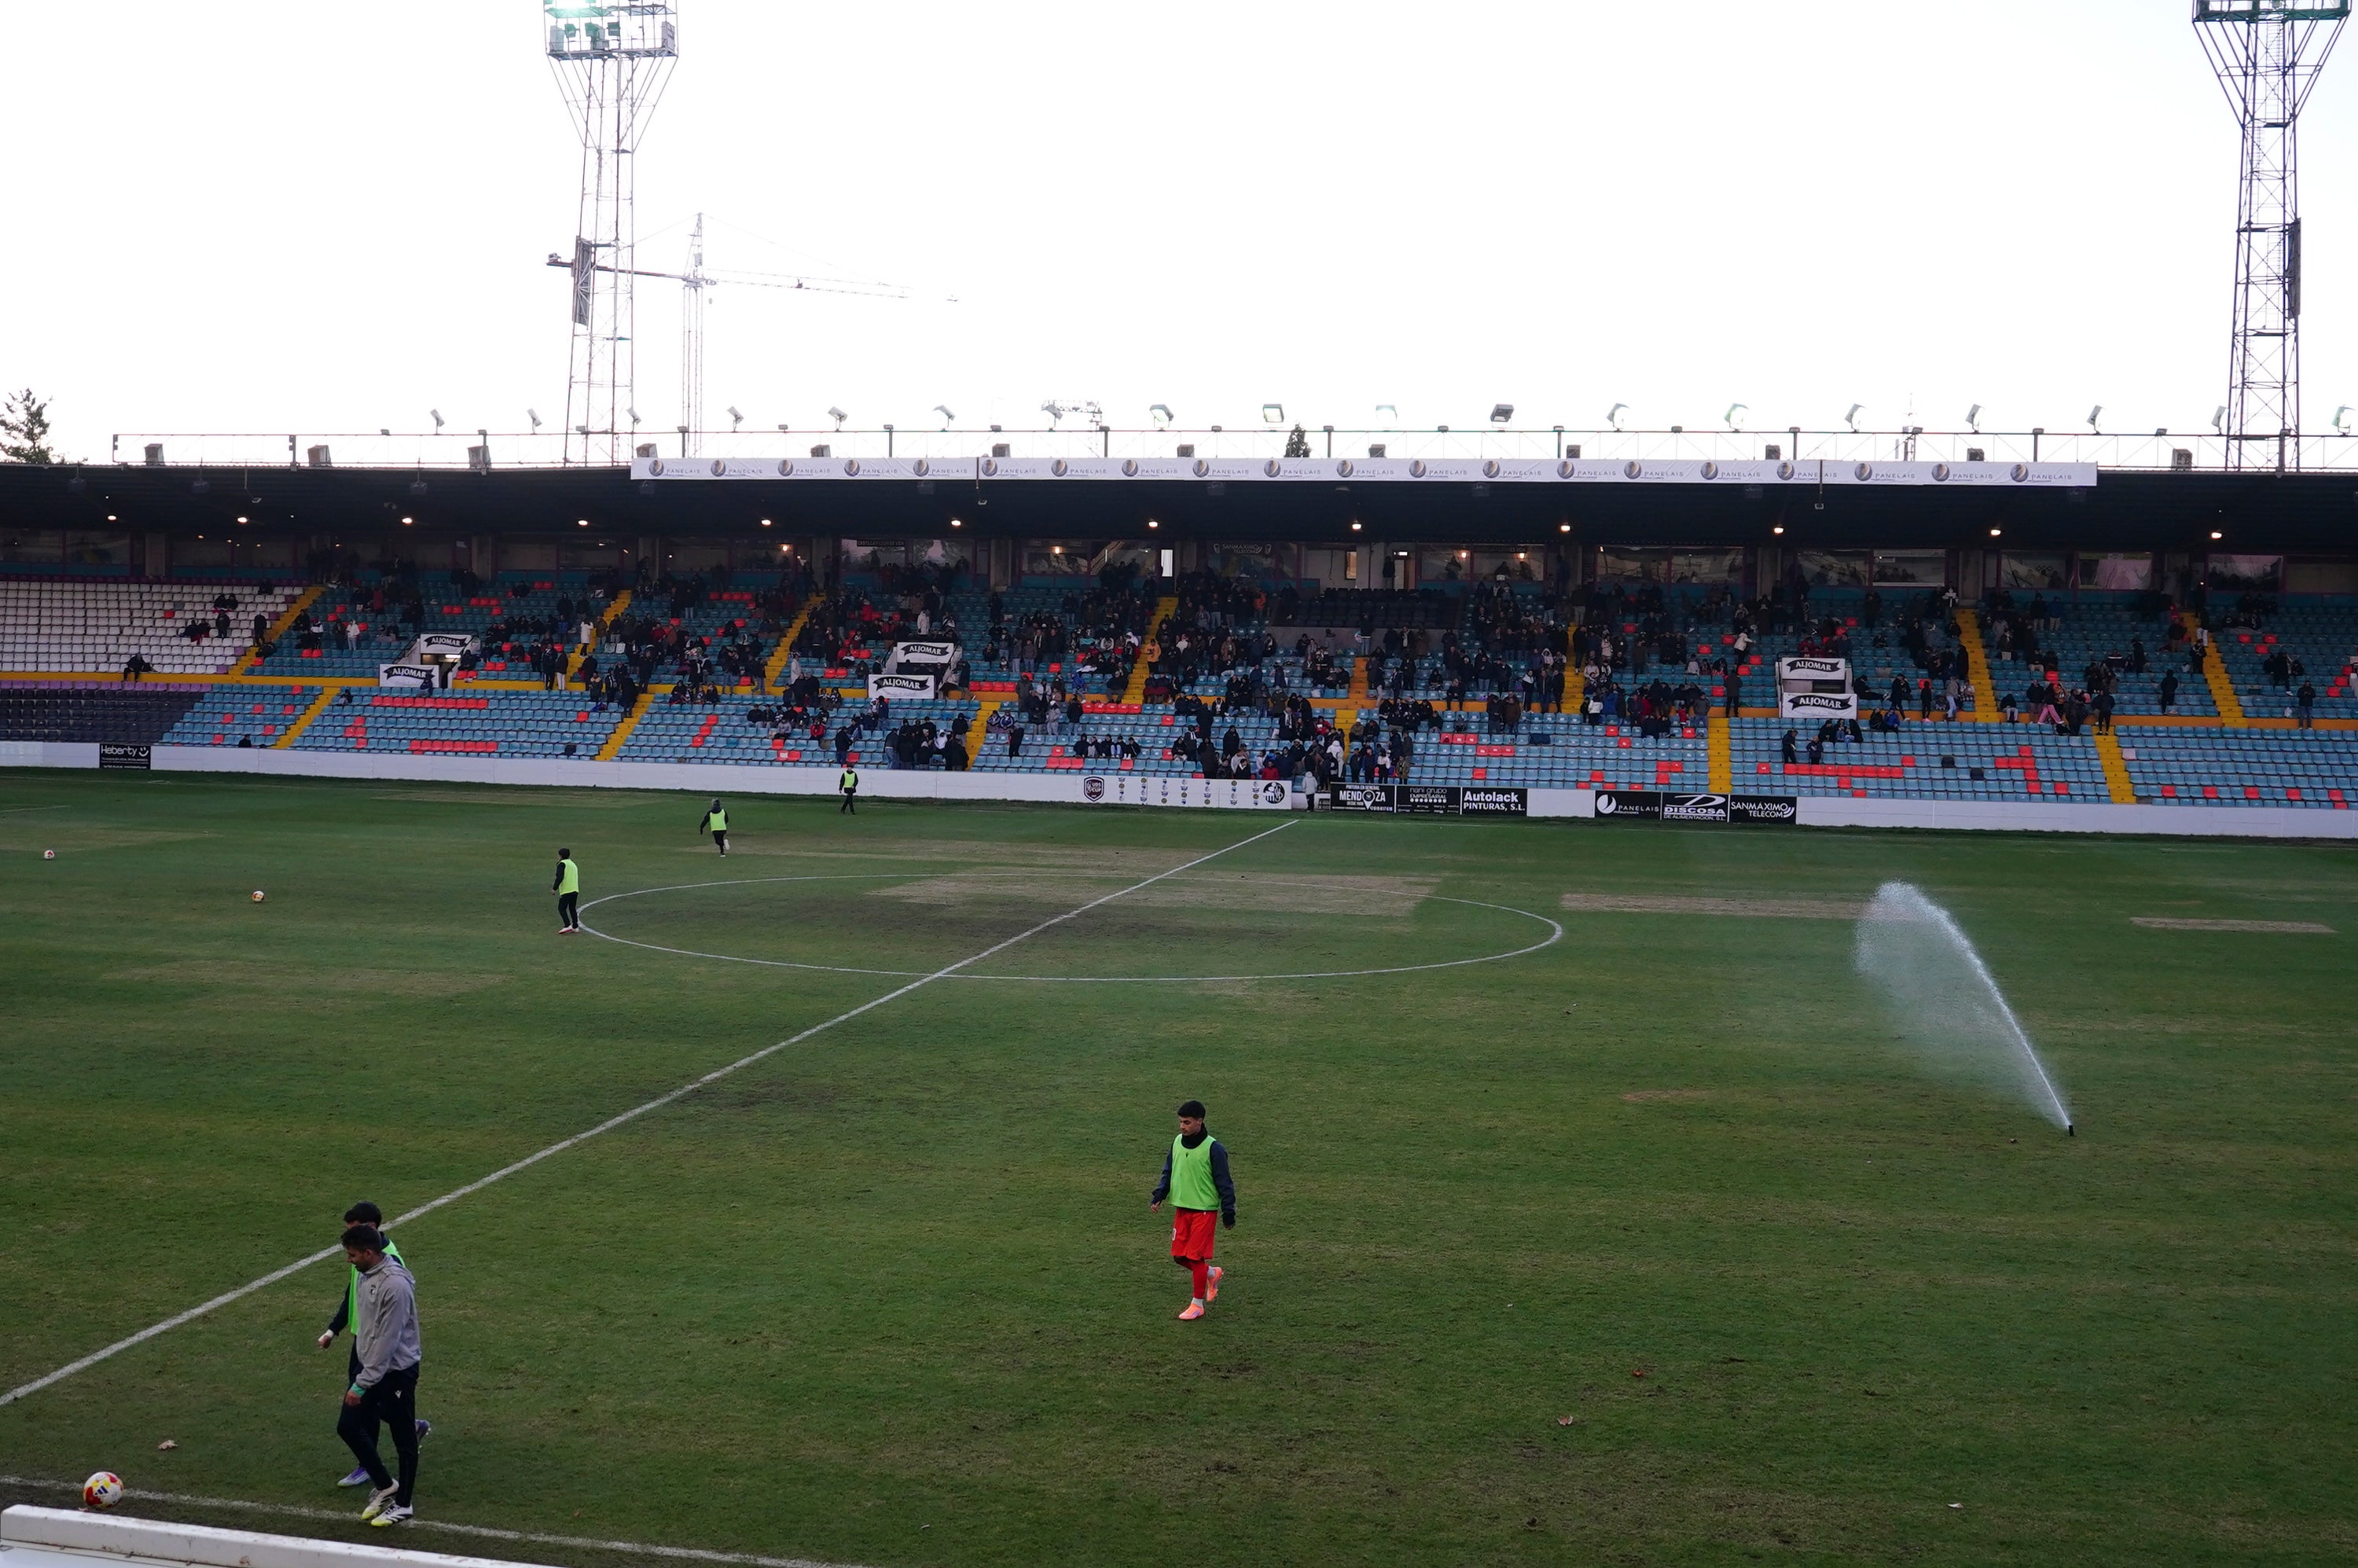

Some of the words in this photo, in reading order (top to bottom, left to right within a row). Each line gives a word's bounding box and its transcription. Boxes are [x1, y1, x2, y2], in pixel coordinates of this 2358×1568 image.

[431, 637, 461, 646] ALJOMAR
[909, 645, 942, 655] ALJOMAR
[1795, 661, 1831, 671] ALJOMAR
[392, 667, 426, 678] ALJOMAR
[882, 678, 921, 689] ALJOMAR
[1798, 696, 1842, 708] ALJOMAR
[101, 744, 138, 757] Heberty
[1464, 791, 1519, 802] Autolack
[1463, 802, 1508, 812] PINTURAS,
[1618, 804, 1659, 813] PANELAIS
[1663, 806, 1726, 815] DISCOSA
